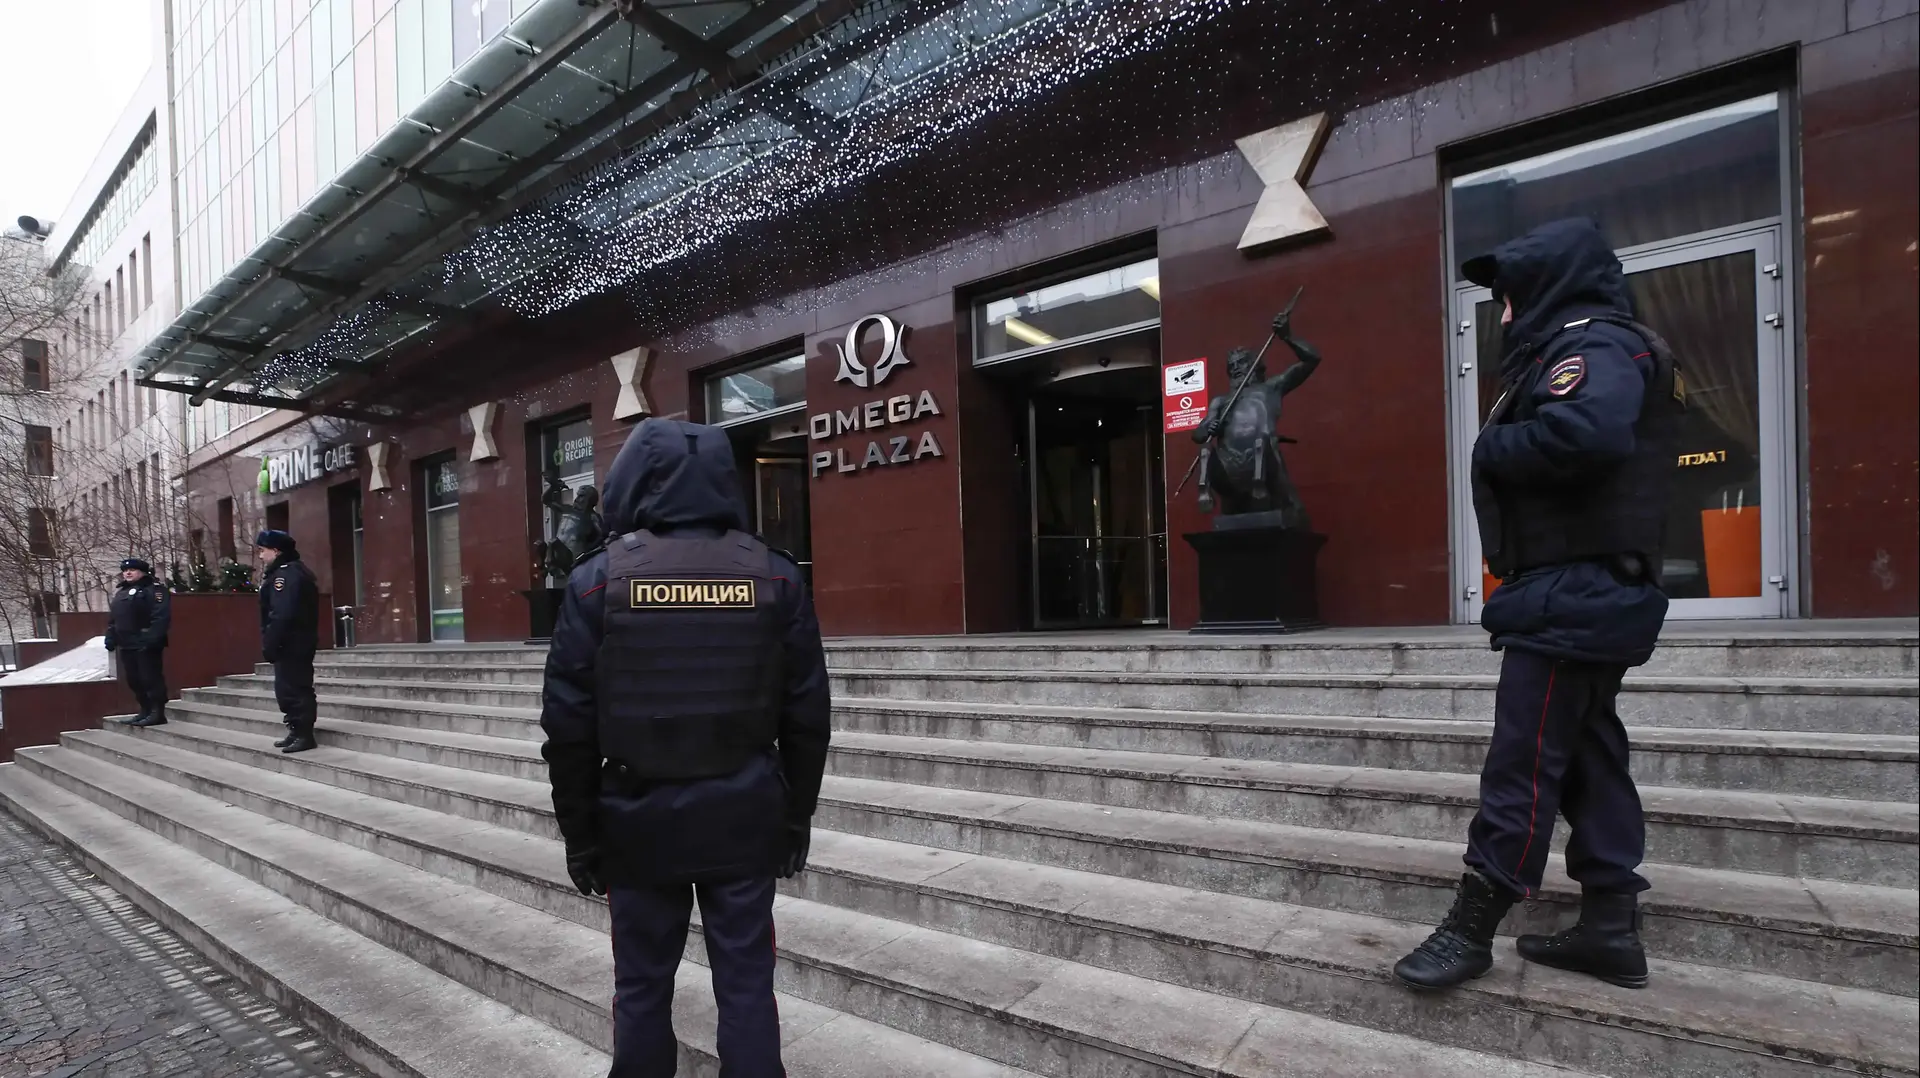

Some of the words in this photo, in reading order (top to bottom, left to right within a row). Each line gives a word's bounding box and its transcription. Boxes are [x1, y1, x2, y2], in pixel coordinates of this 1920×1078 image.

[810, 389, 940, 440] OMEGA
[269, 440, 322, 493] PRIME
[325, 443, 356, 471] CAFE
[812, 431, 942, 478] PLAZA
[636, 584, 750, 605] ПОЛИЦИЯ
